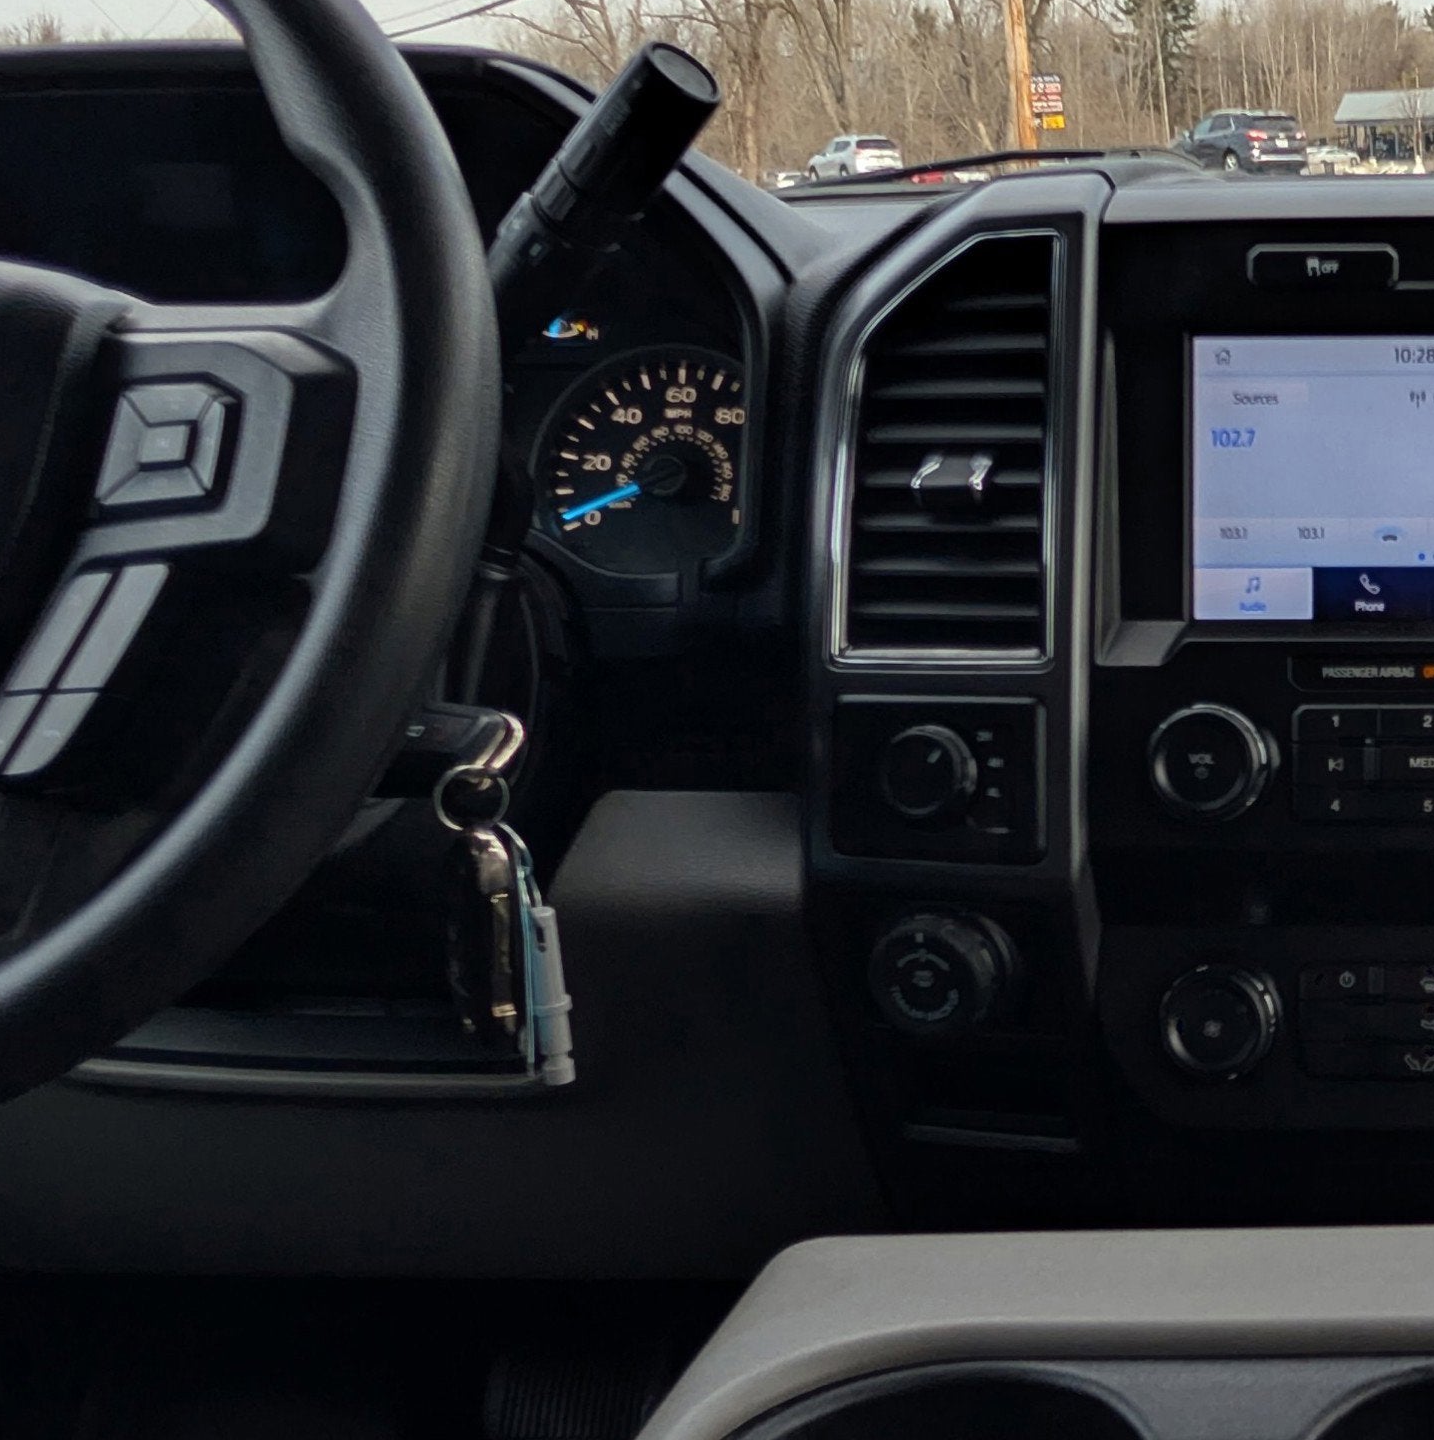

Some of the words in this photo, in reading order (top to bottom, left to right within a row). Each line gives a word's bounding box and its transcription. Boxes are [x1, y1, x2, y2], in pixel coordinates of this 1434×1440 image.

[666, 386, 697, 404] 60
[1232, 390, 1280, 406] Sources
[714, 408, 746, 425] 80
[1210, 428, 1257, 448] 102.7
[582, 454, 612, 471] 20
[1354, 599, 1386, 613] Phone
[1331, 714, 1341, 728] 1
[1422, 714, 1433, 728] 2
[1330, 798, 1341, 812] 4
[1423, 799, 1434, 813] 5
